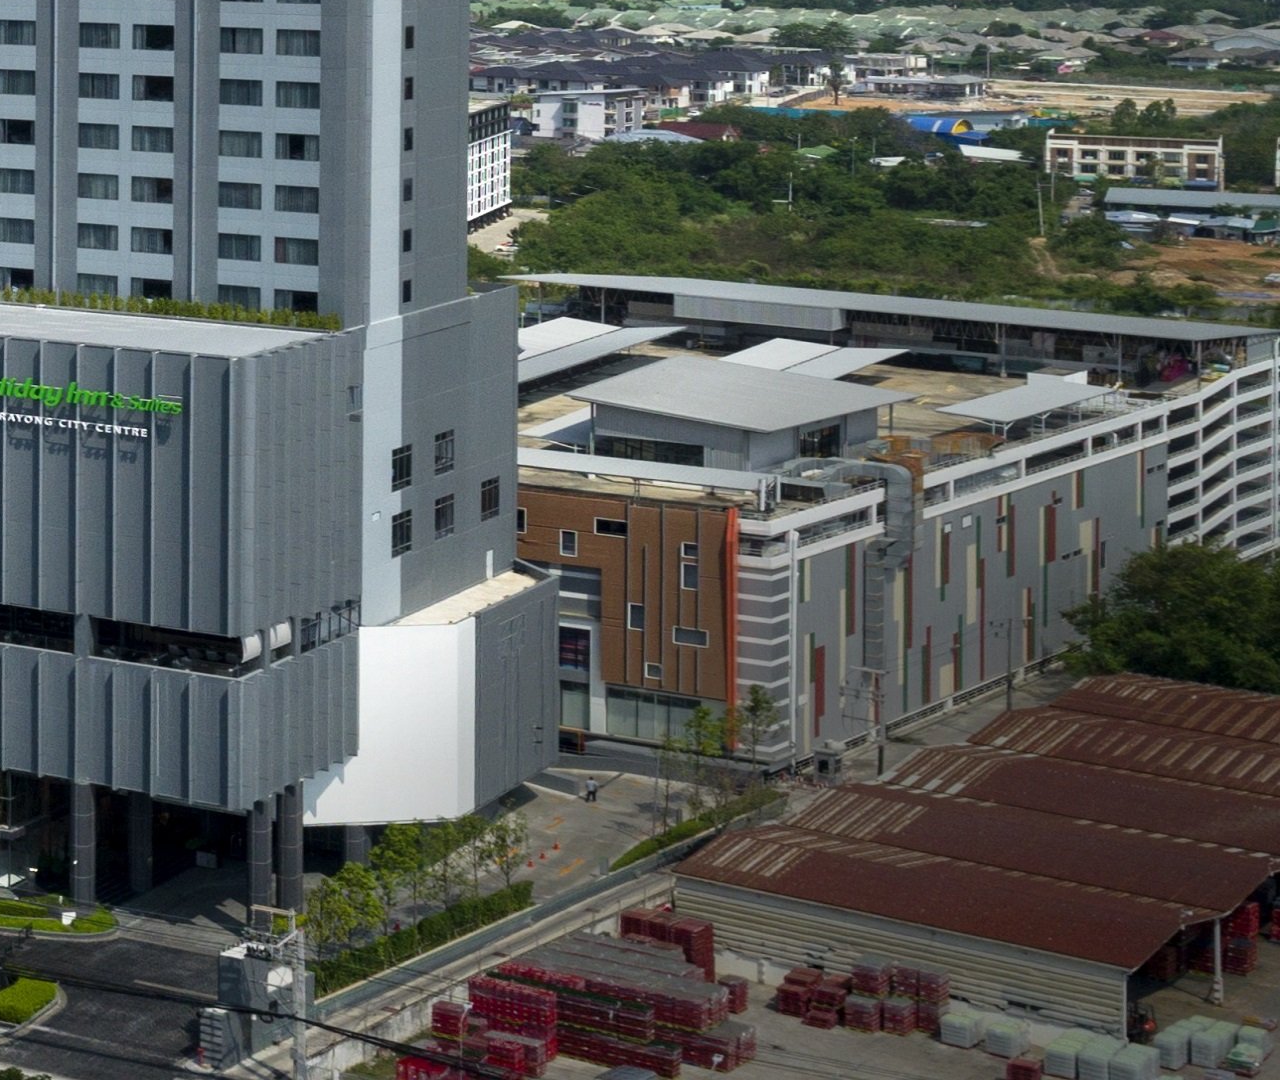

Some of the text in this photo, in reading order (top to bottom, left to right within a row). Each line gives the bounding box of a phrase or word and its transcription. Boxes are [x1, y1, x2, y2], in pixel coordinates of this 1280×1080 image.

[67, 381, 109, 407] Inn
[110, 393, 125, 409] &
[126, 394, 182, 415] Suites
[0, 412, 148, 438] RAYONG CITY CENTRE
